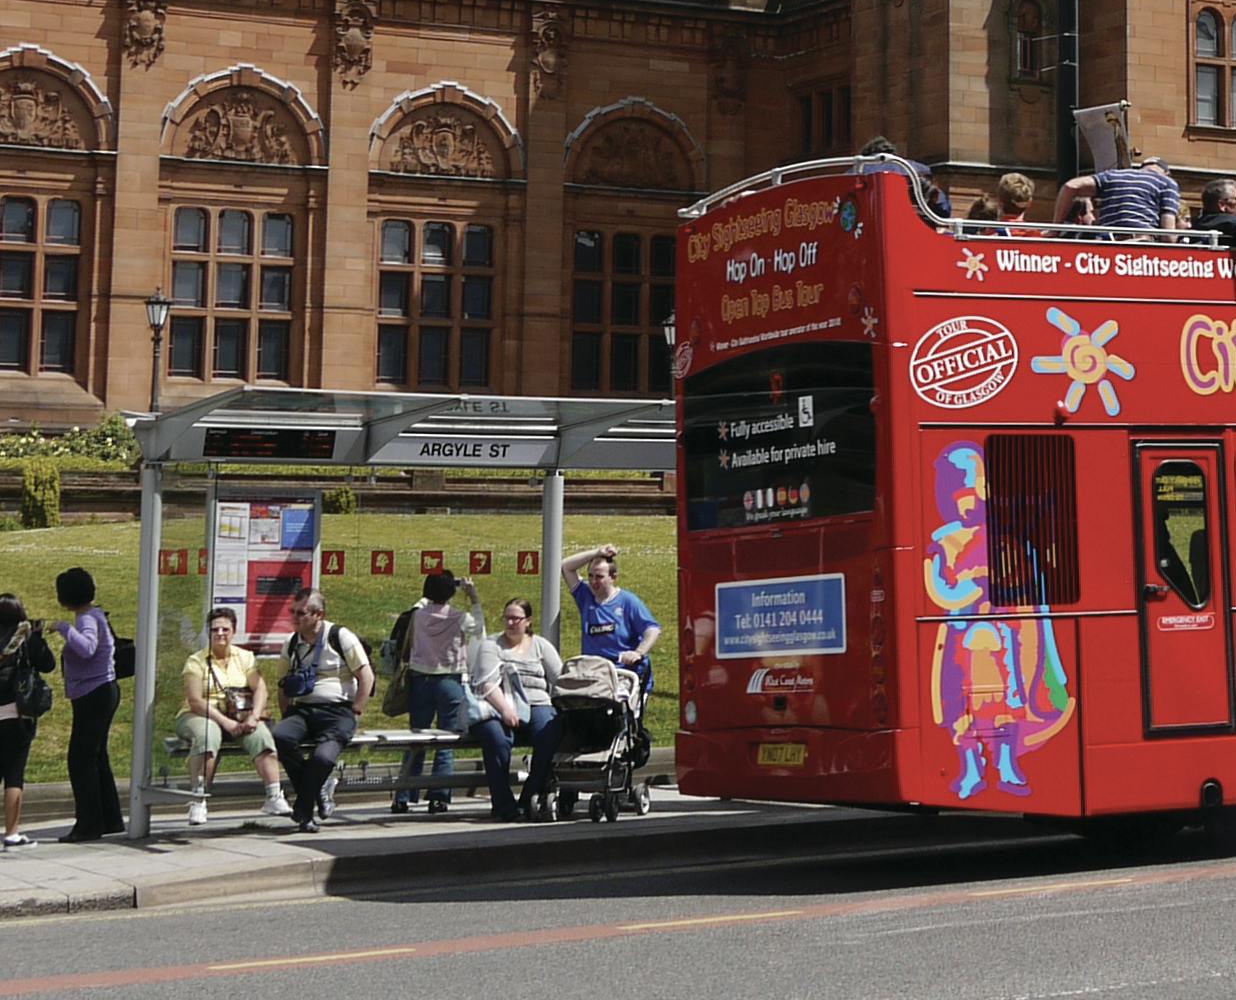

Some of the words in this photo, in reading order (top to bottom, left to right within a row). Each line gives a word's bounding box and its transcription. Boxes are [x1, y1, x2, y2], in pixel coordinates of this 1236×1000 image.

[726, 259, 747, 284] Hop
[750, 252, 765, 277] On
[774, 248, 796, 274] Hop
[799, 241, 819, 268] Off
[996, 249, 1061, 273] Winner
[1075, 252, 1111, 276] City
[1115, 255, 1215, 279] Sightseeing
[772, 285, 795, 312] Bus
[796, 280, 824, 307] Tour
[936, 319, 969, 338] TOUR
[917, 340, 1012, 384] OFFICIAL
[936, 391, 953, 404] OF
[954, 371, 1005, 405] GLASGOW
[731, 420, 750, 440] Fully
[751, 413, 794, 435] accessible
[420, 442, 483, 457] ARGYLE
[489, 444, 510, 458] ST
[731, 449, 769, 469] Available
[770, 446, 783, 462] for
[784, 443, 816, 464] private
[817, 439, 837, 455] hire
[751, 589, 806, 607] Information
[753, 612, 777, 628] 0141
[779, 610, 797, 627] 204
[799, 609, 823, 626] 0444
